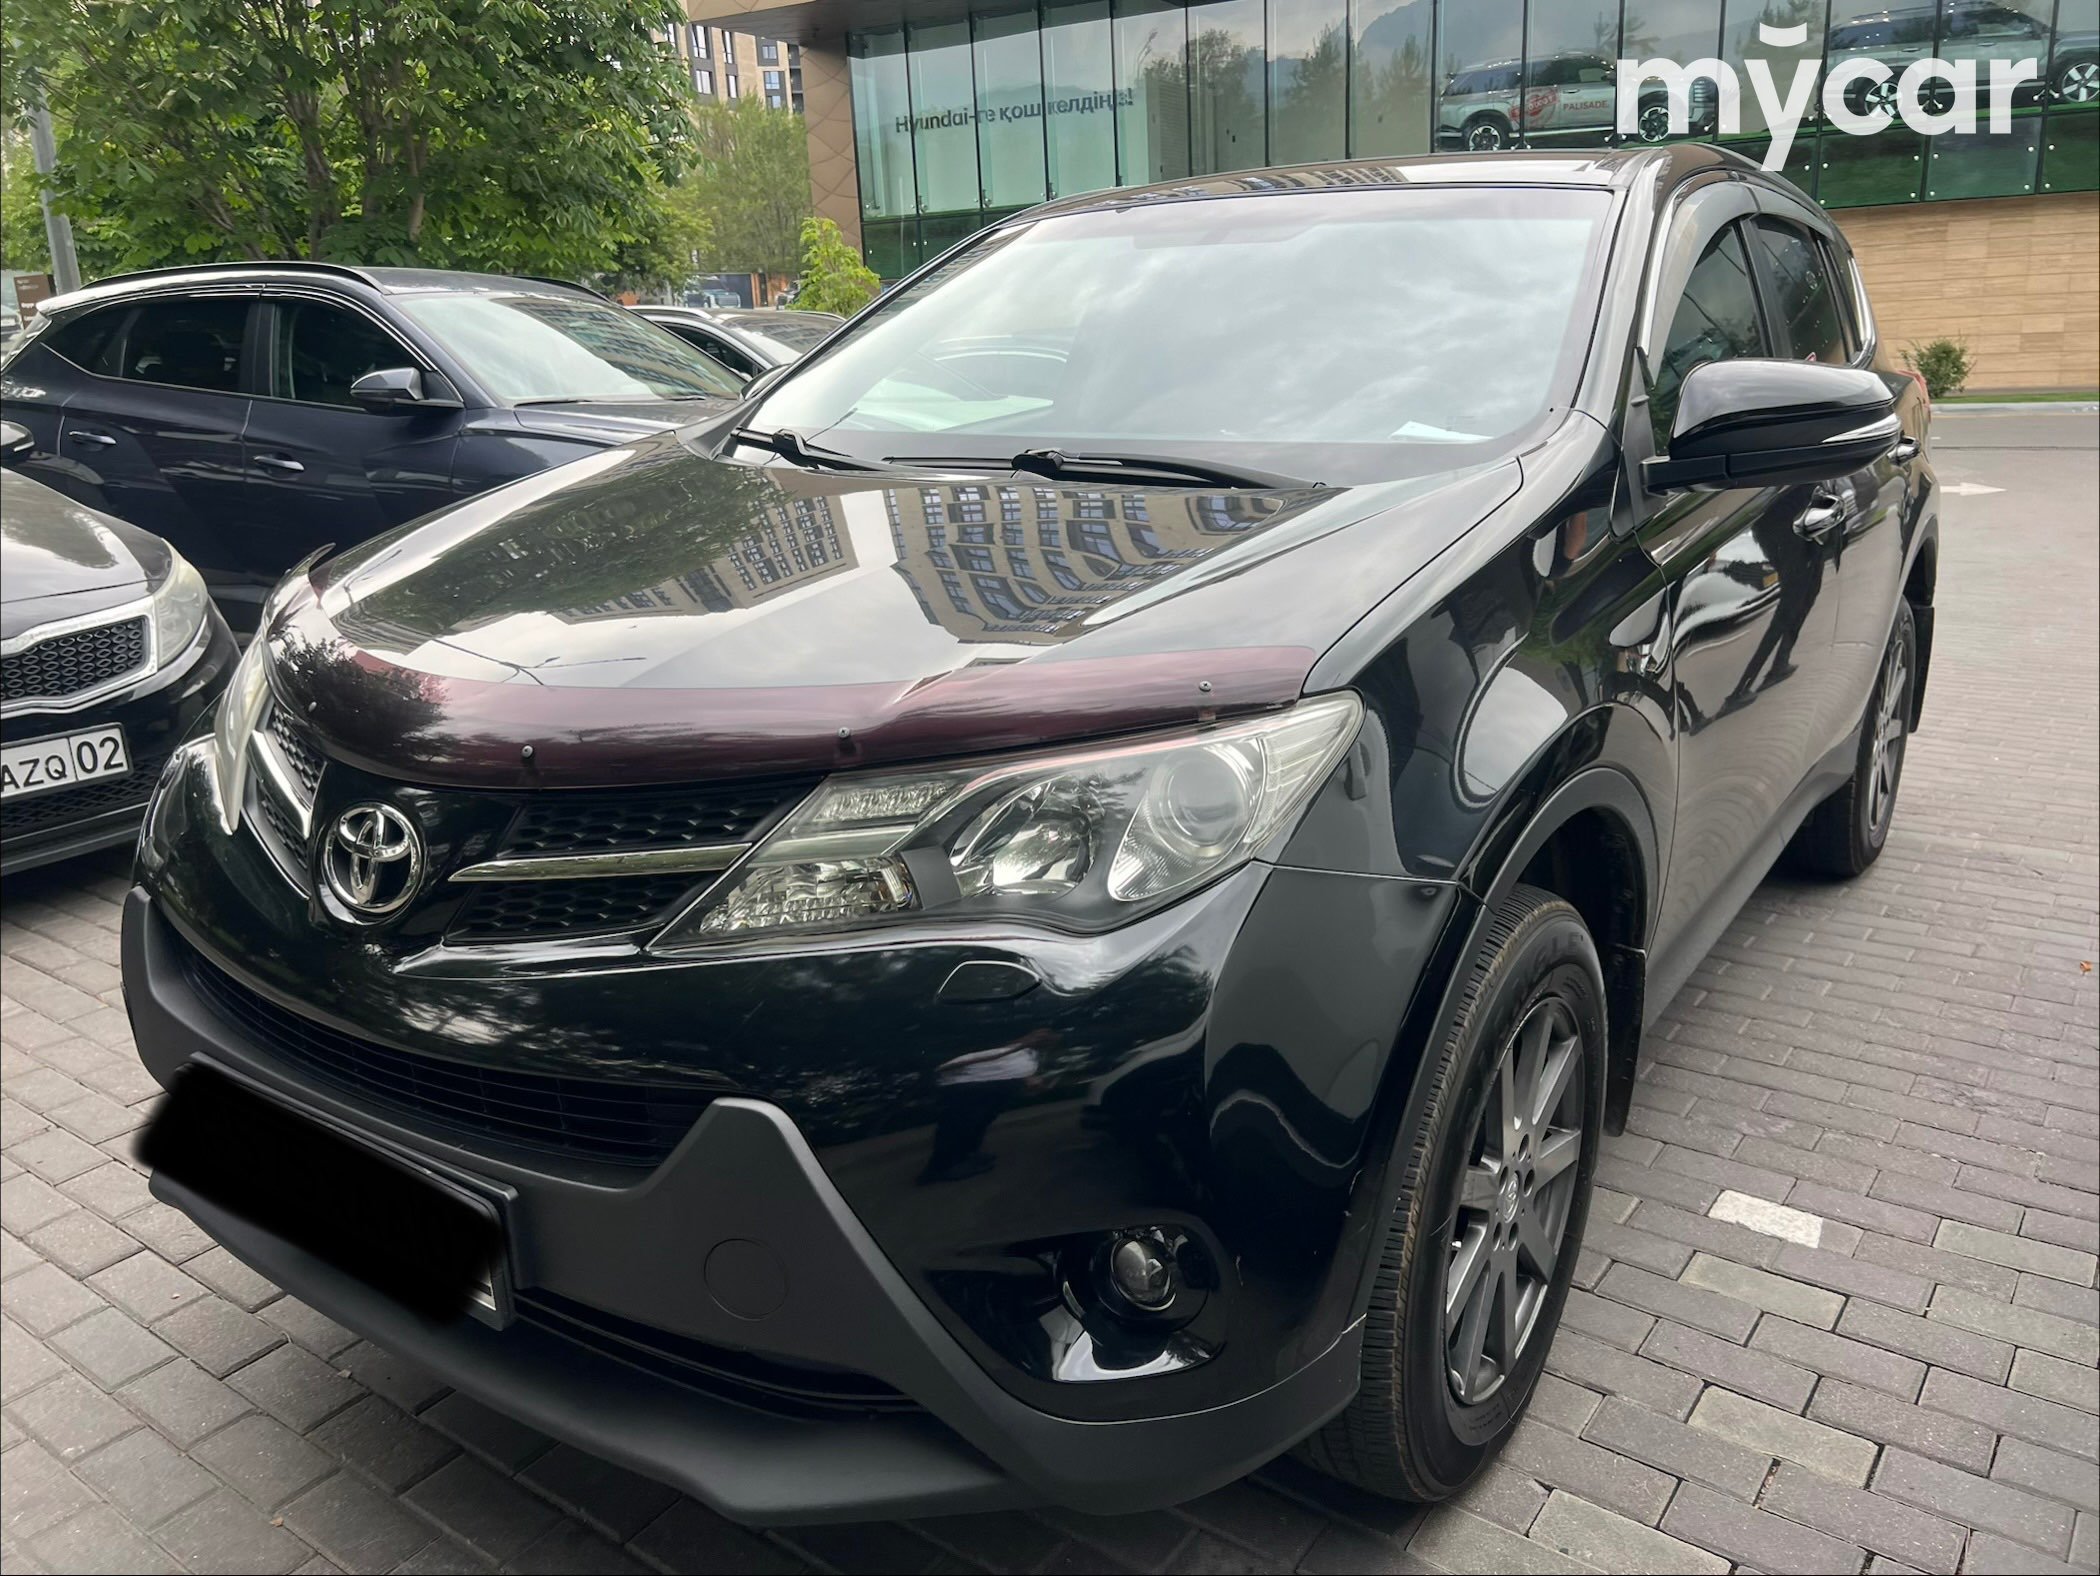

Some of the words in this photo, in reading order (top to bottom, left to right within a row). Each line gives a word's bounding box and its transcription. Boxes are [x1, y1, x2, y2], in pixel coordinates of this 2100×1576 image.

[999, 102, 1041, 122] қош
[1047, 87, 1134, 115] келдіңз!
[76, 736, 124, 774] 02
